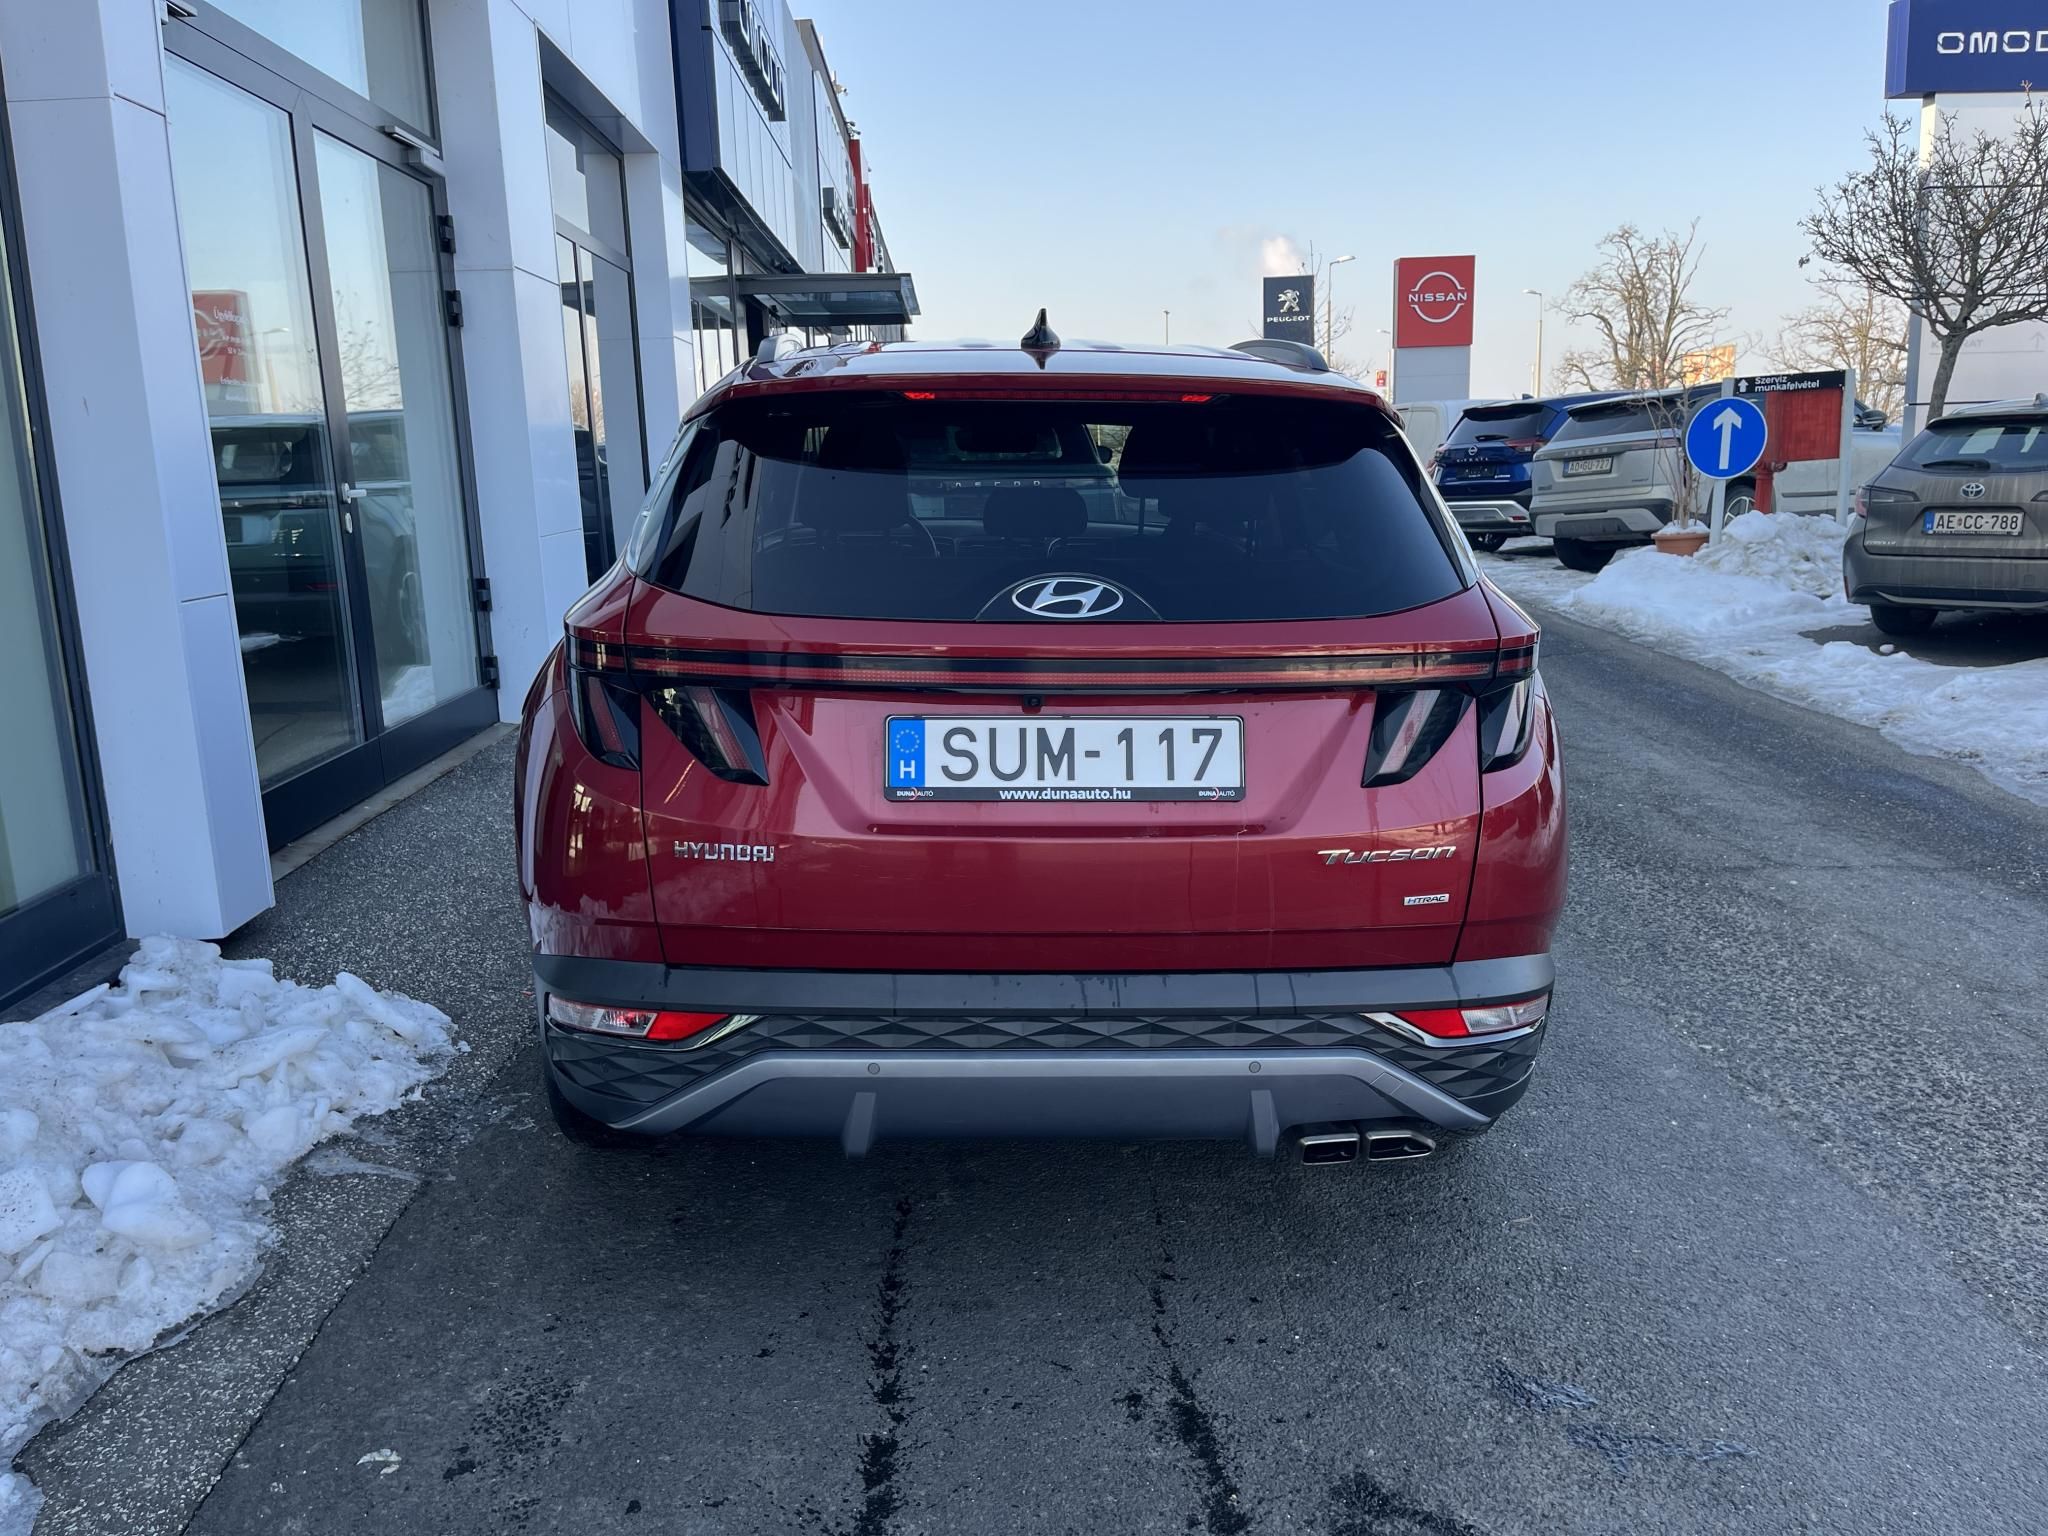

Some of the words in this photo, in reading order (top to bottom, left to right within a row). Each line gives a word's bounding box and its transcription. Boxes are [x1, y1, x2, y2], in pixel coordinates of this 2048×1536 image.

[1408, 292, 1468, 302] NISSAN
[1266, 315, 1311, 323] PEUGEOT
[1755, 376, 1788, 385] Szerviz
[1755, 380, 1820, 392] munkafelvétel
[1936, 515, 1957, 530] AE
[1963, 515, 2019, 531] CC-788
[940, 727, 1223, 782] SUM-117
[900, 760, 916, 780] H
[999, 788, 1132, 800] www.dunaauto.hu
[674, 840, 775, 862] HYUNDAI
[1407, 894, 1446, 905] HTRAC
